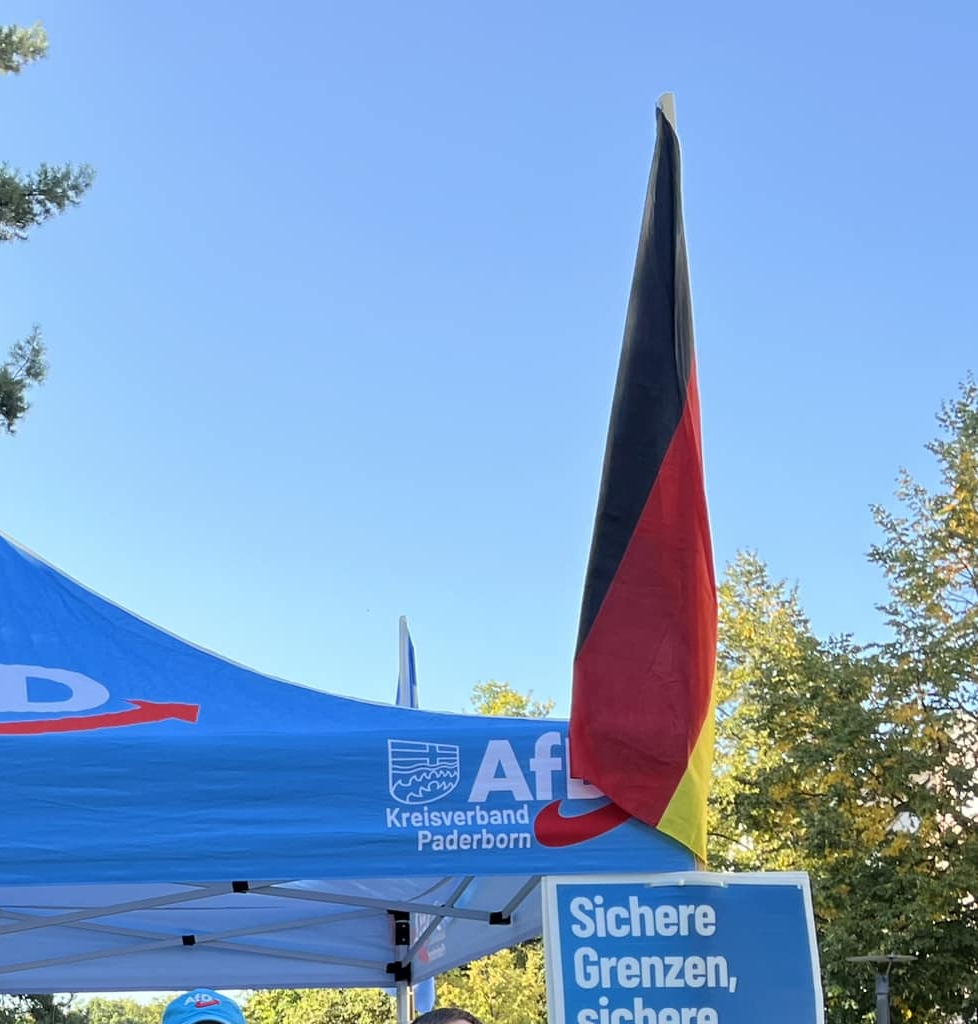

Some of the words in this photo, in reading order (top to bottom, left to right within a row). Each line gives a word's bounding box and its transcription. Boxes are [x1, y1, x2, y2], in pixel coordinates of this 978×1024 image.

[386, 805, 529, 828] Kreisverband
[417, 829, 531, 851] Paderborn
[569, 896, 717, 938] Sichere
[573, 946, 738, 993] Grenzen,
